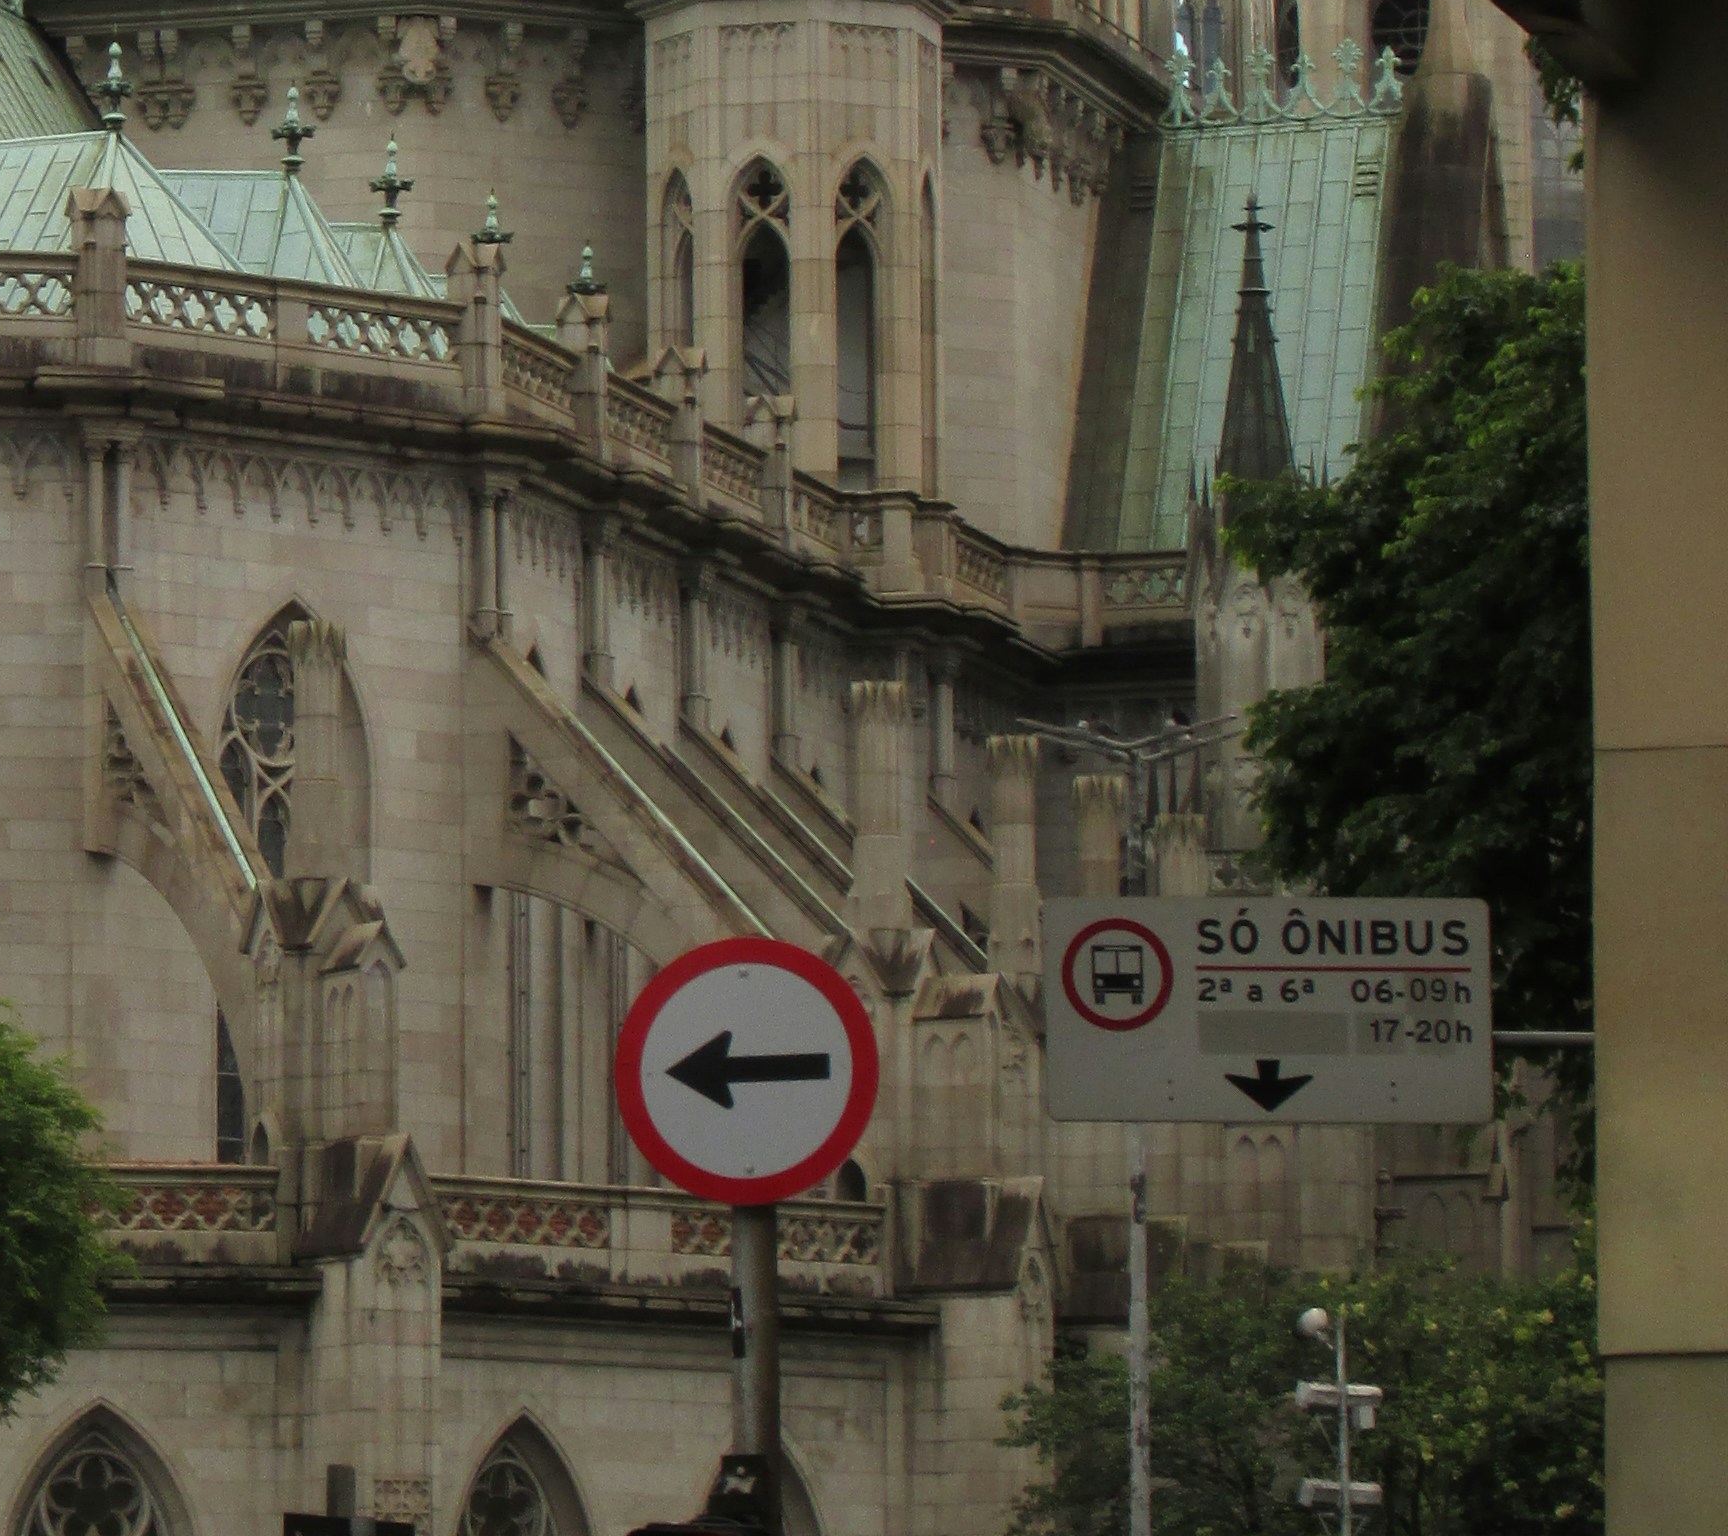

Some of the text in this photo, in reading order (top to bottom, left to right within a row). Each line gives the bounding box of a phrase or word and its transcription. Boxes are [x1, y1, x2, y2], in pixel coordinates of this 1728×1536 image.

[1196, 907, 1471, 957] SÓ ÔNIBUS
[1246, 982, 1263, 1003] a
